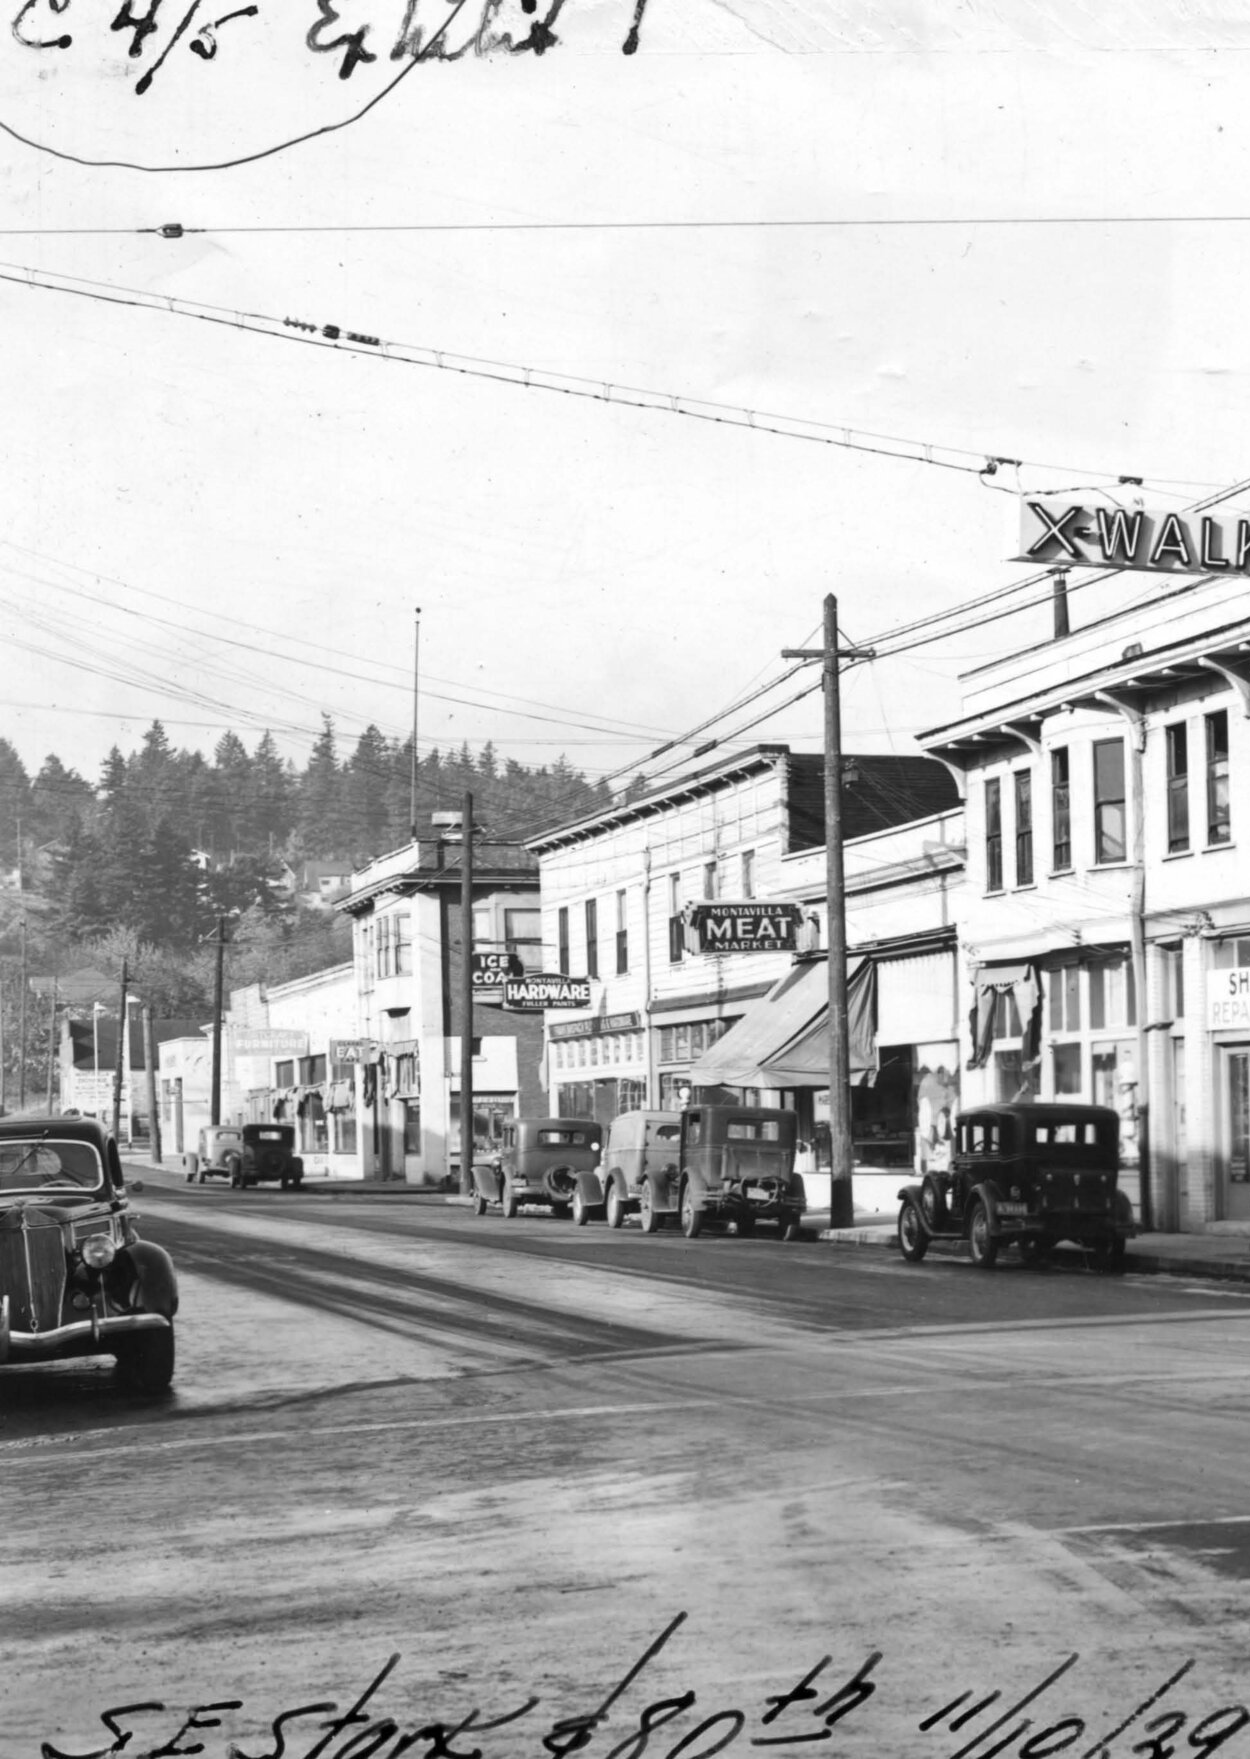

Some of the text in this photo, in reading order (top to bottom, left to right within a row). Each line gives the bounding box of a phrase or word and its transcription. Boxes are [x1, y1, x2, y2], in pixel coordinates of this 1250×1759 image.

[711, 907, 783, 917] MONTAVILLA
[706, 917, 792, 939] MEAT
[715, 940, 783, 950] MARKET
[480, 955, 509, 968] ICE
[472, 971, 514, 984] COA
[507, 984, 590, 1000] HARDWARE
[236, 1039, 305, 1049] FURNITURE
[337, 1047, 365, 1058] EAT
